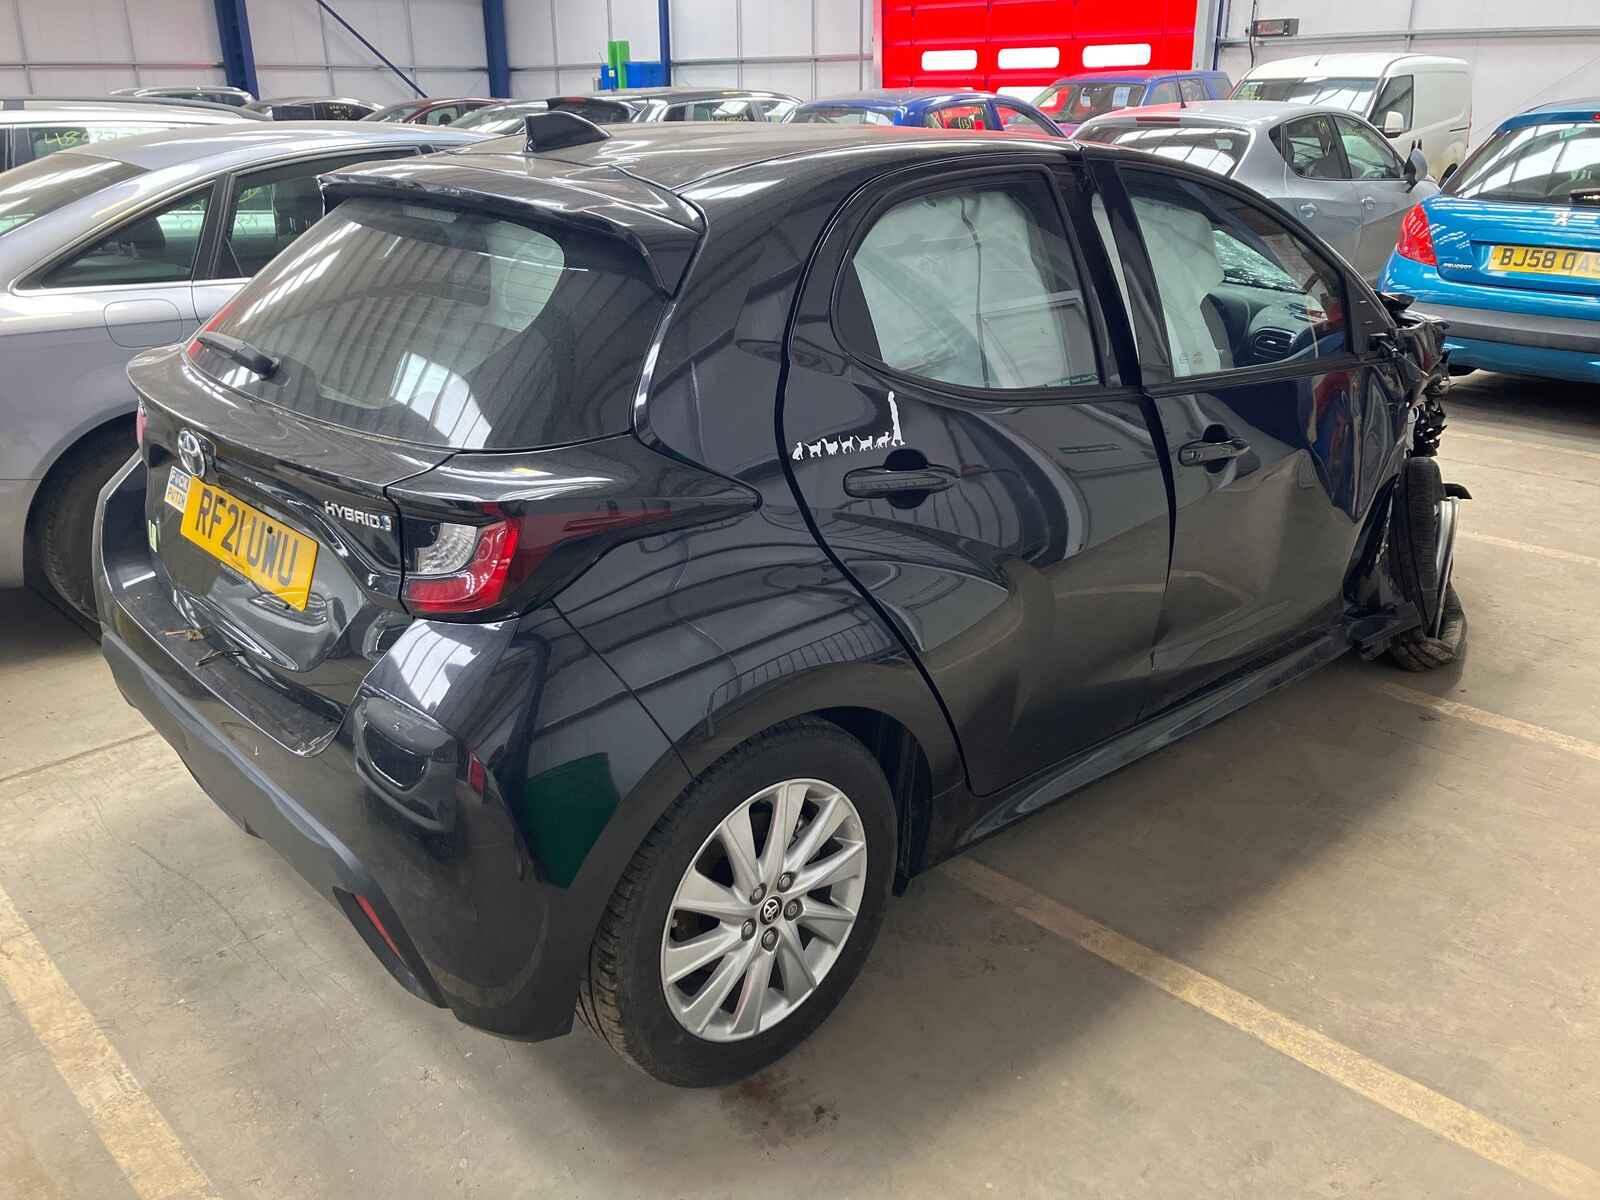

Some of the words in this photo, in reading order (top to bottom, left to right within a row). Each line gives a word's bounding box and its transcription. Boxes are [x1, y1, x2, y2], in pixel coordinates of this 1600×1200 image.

[1500, 248, 1556, 269] BJ58
[195, 488, 246, 556] RF21
[324, 500, 380, 529] HYBRID
